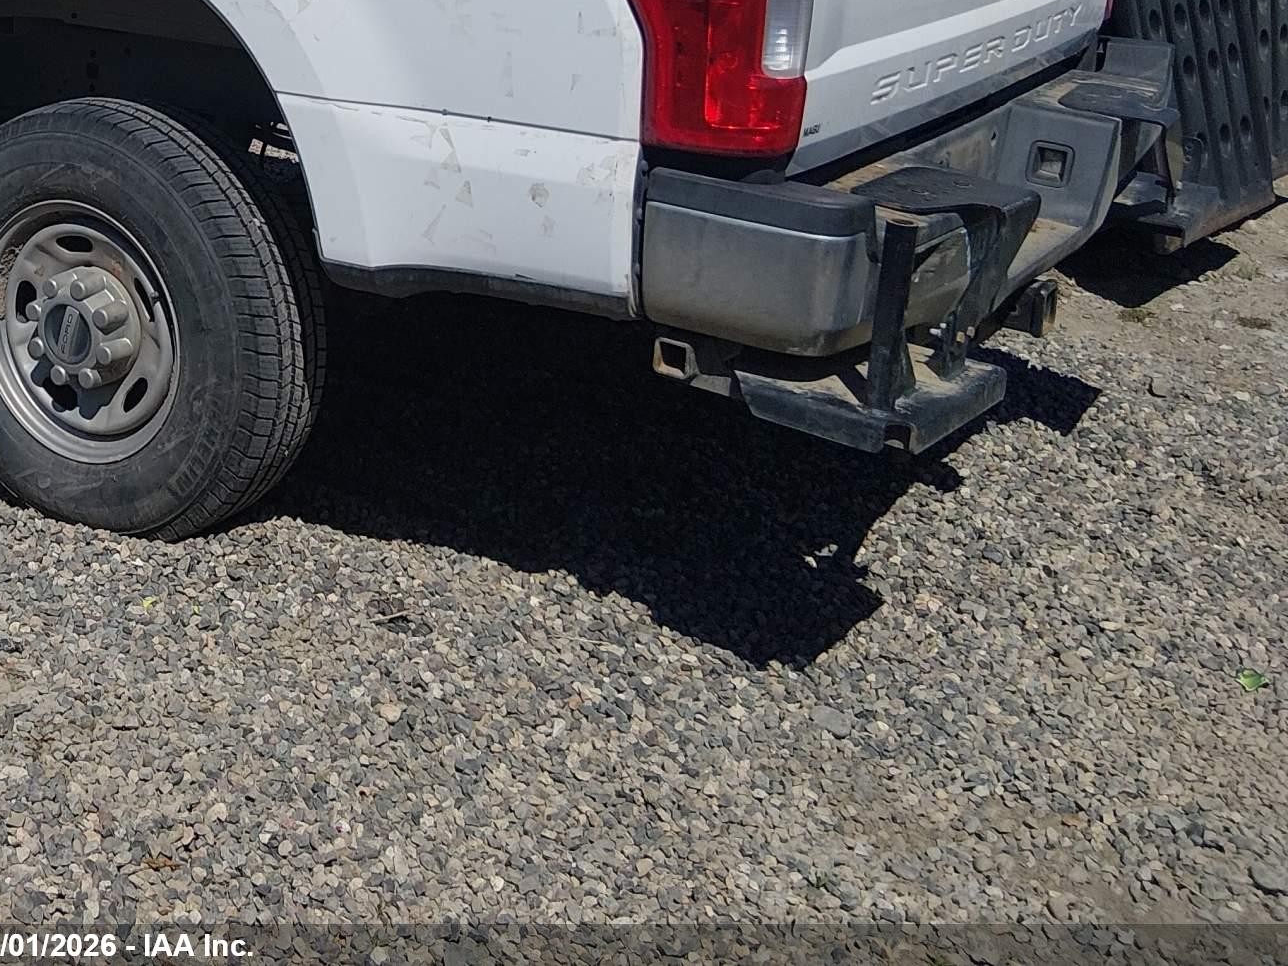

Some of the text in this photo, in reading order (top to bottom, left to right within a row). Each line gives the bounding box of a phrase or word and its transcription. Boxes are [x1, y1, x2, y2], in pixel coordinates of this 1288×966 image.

[870, 2, 1083, 106] SUPER DUTY
[60, 313, 74, 354] FORD
